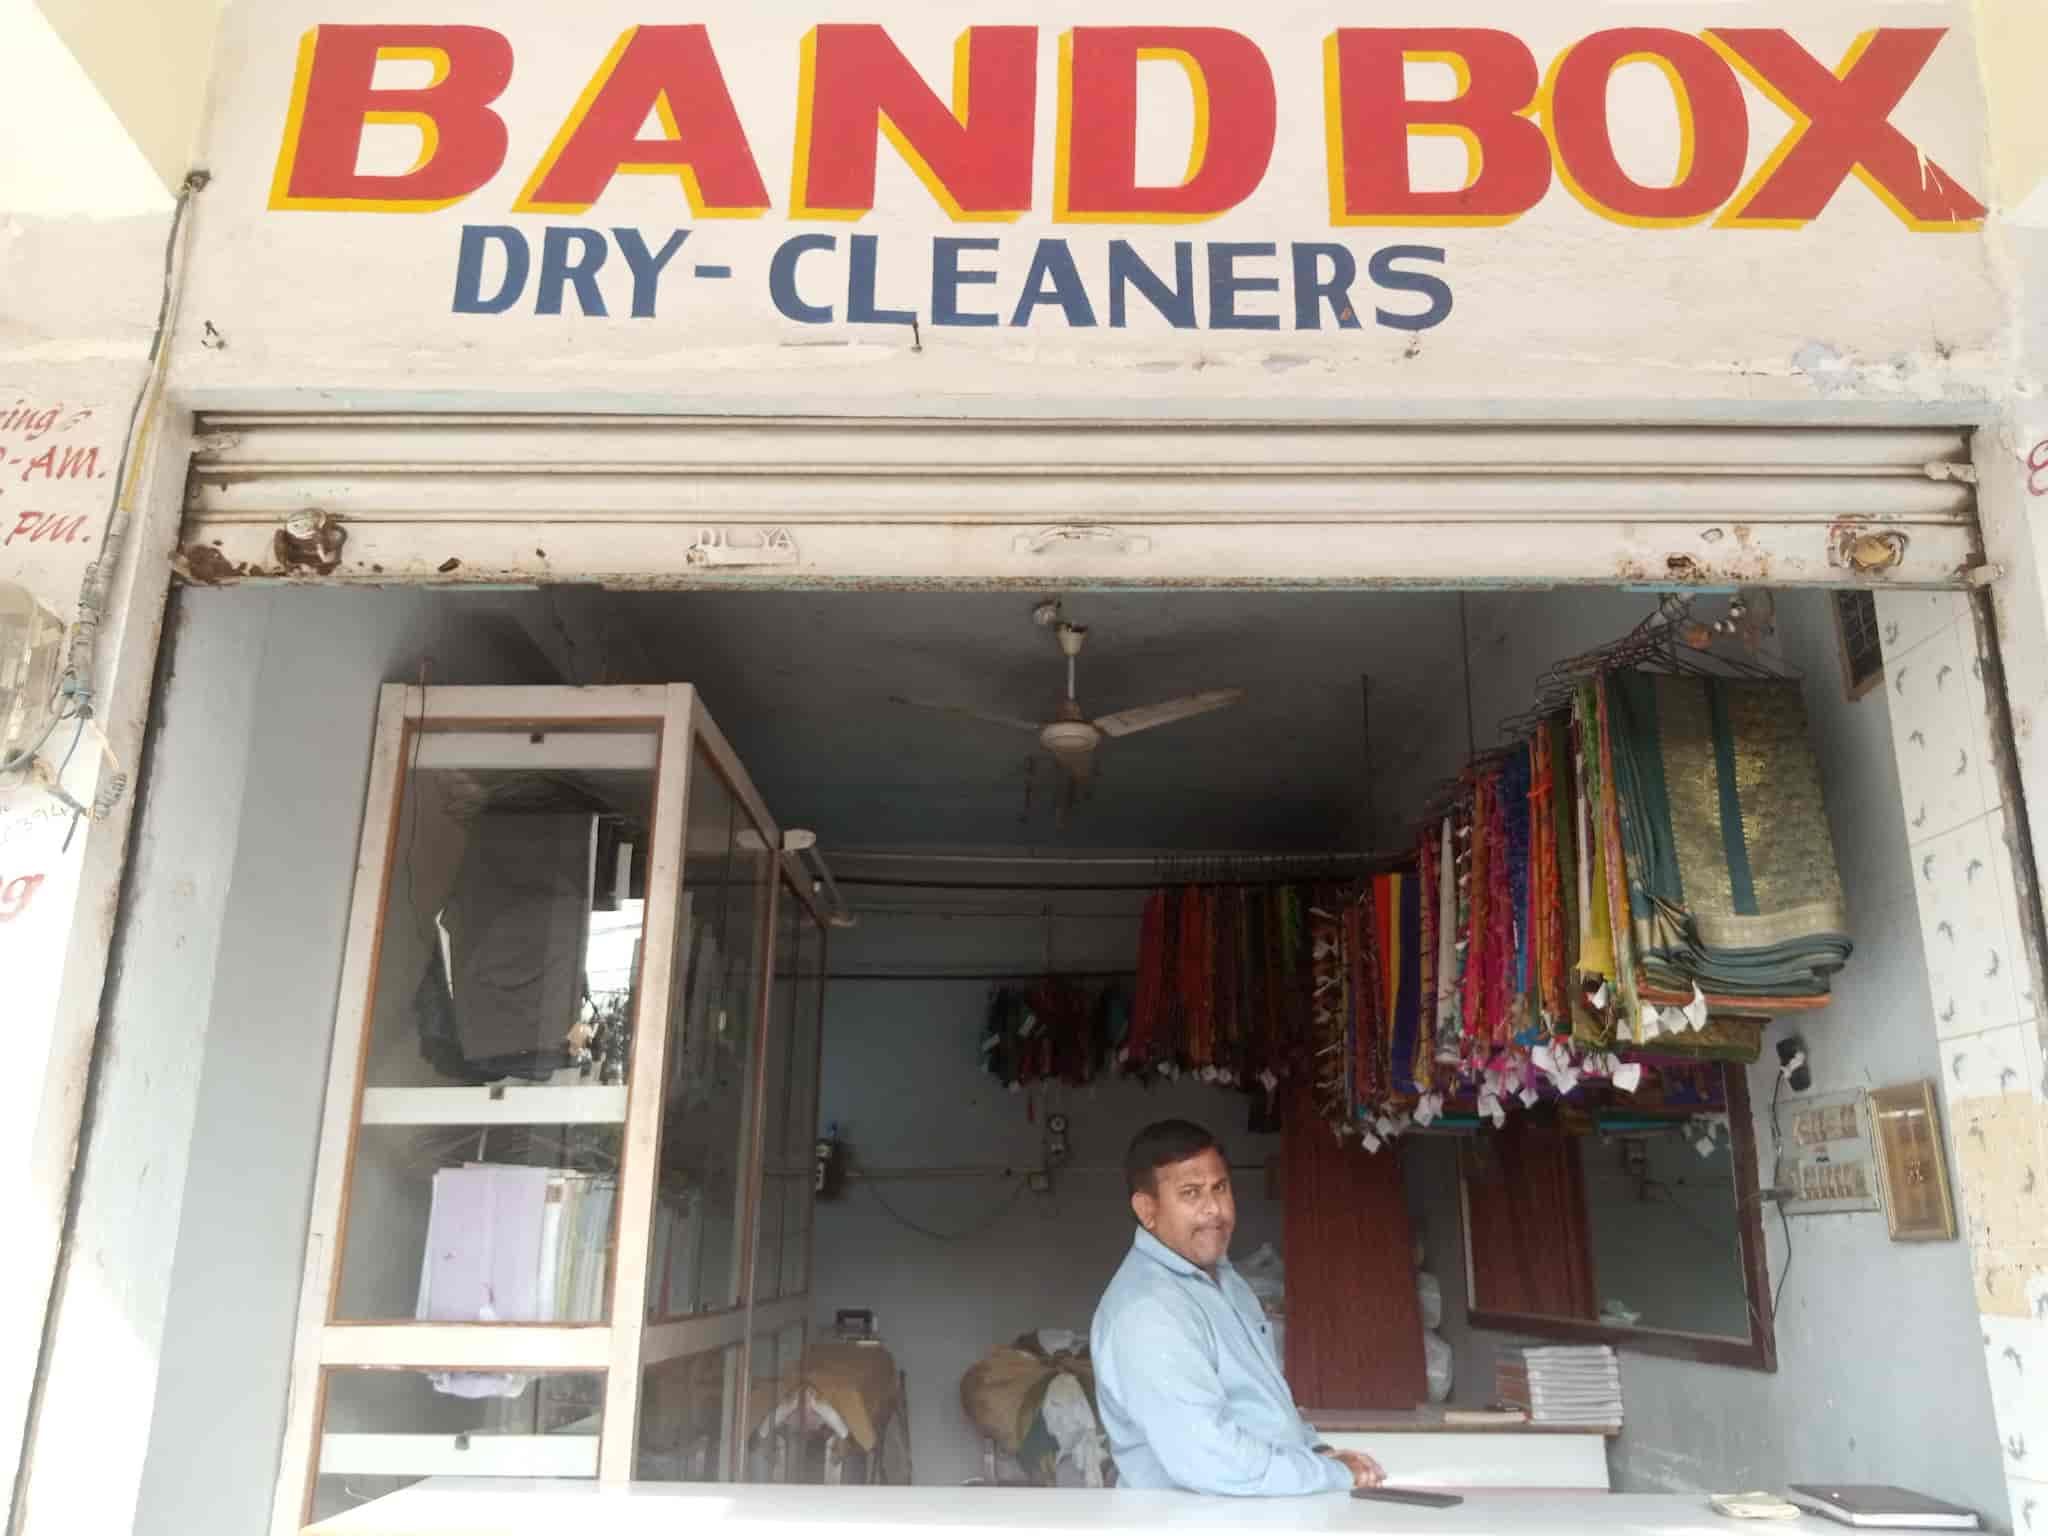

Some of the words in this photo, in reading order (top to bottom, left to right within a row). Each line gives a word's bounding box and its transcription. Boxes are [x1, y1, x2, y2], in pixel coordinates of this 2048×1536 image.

[268, 24, 1276, 225] BAND
[1322, 26, 1986, 233] BOX
[769, 233, 1453, 330] CLEANERS
